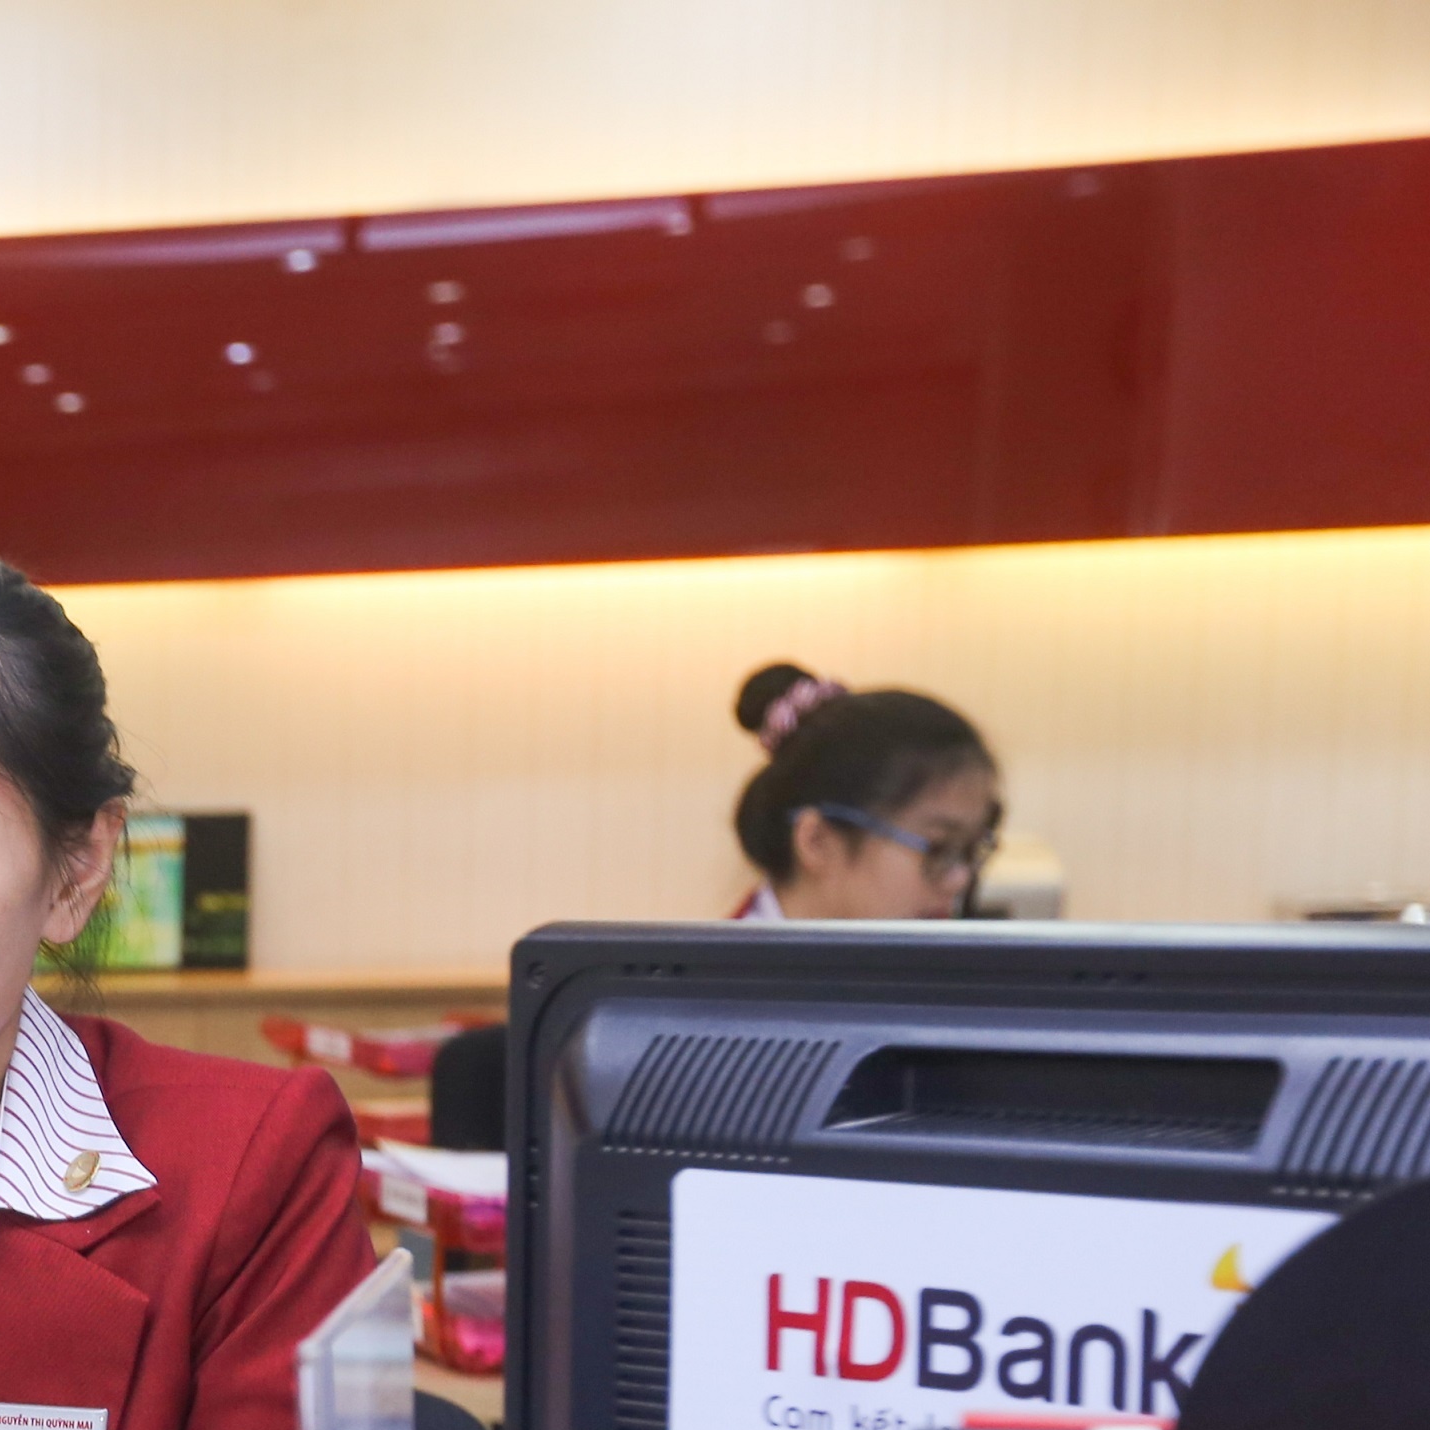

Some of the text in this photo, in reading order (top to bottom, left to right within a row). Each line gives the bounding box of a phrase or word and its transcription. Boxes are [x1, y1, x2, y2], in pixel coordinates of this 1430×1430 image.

[766, 1272, 1205, 1415] HDBank
[31, 1417, 44, 1429] THỊ
[46, 1417, 75, 1429] QUỲNH
[77, 1421, 93, 1430] MAI
